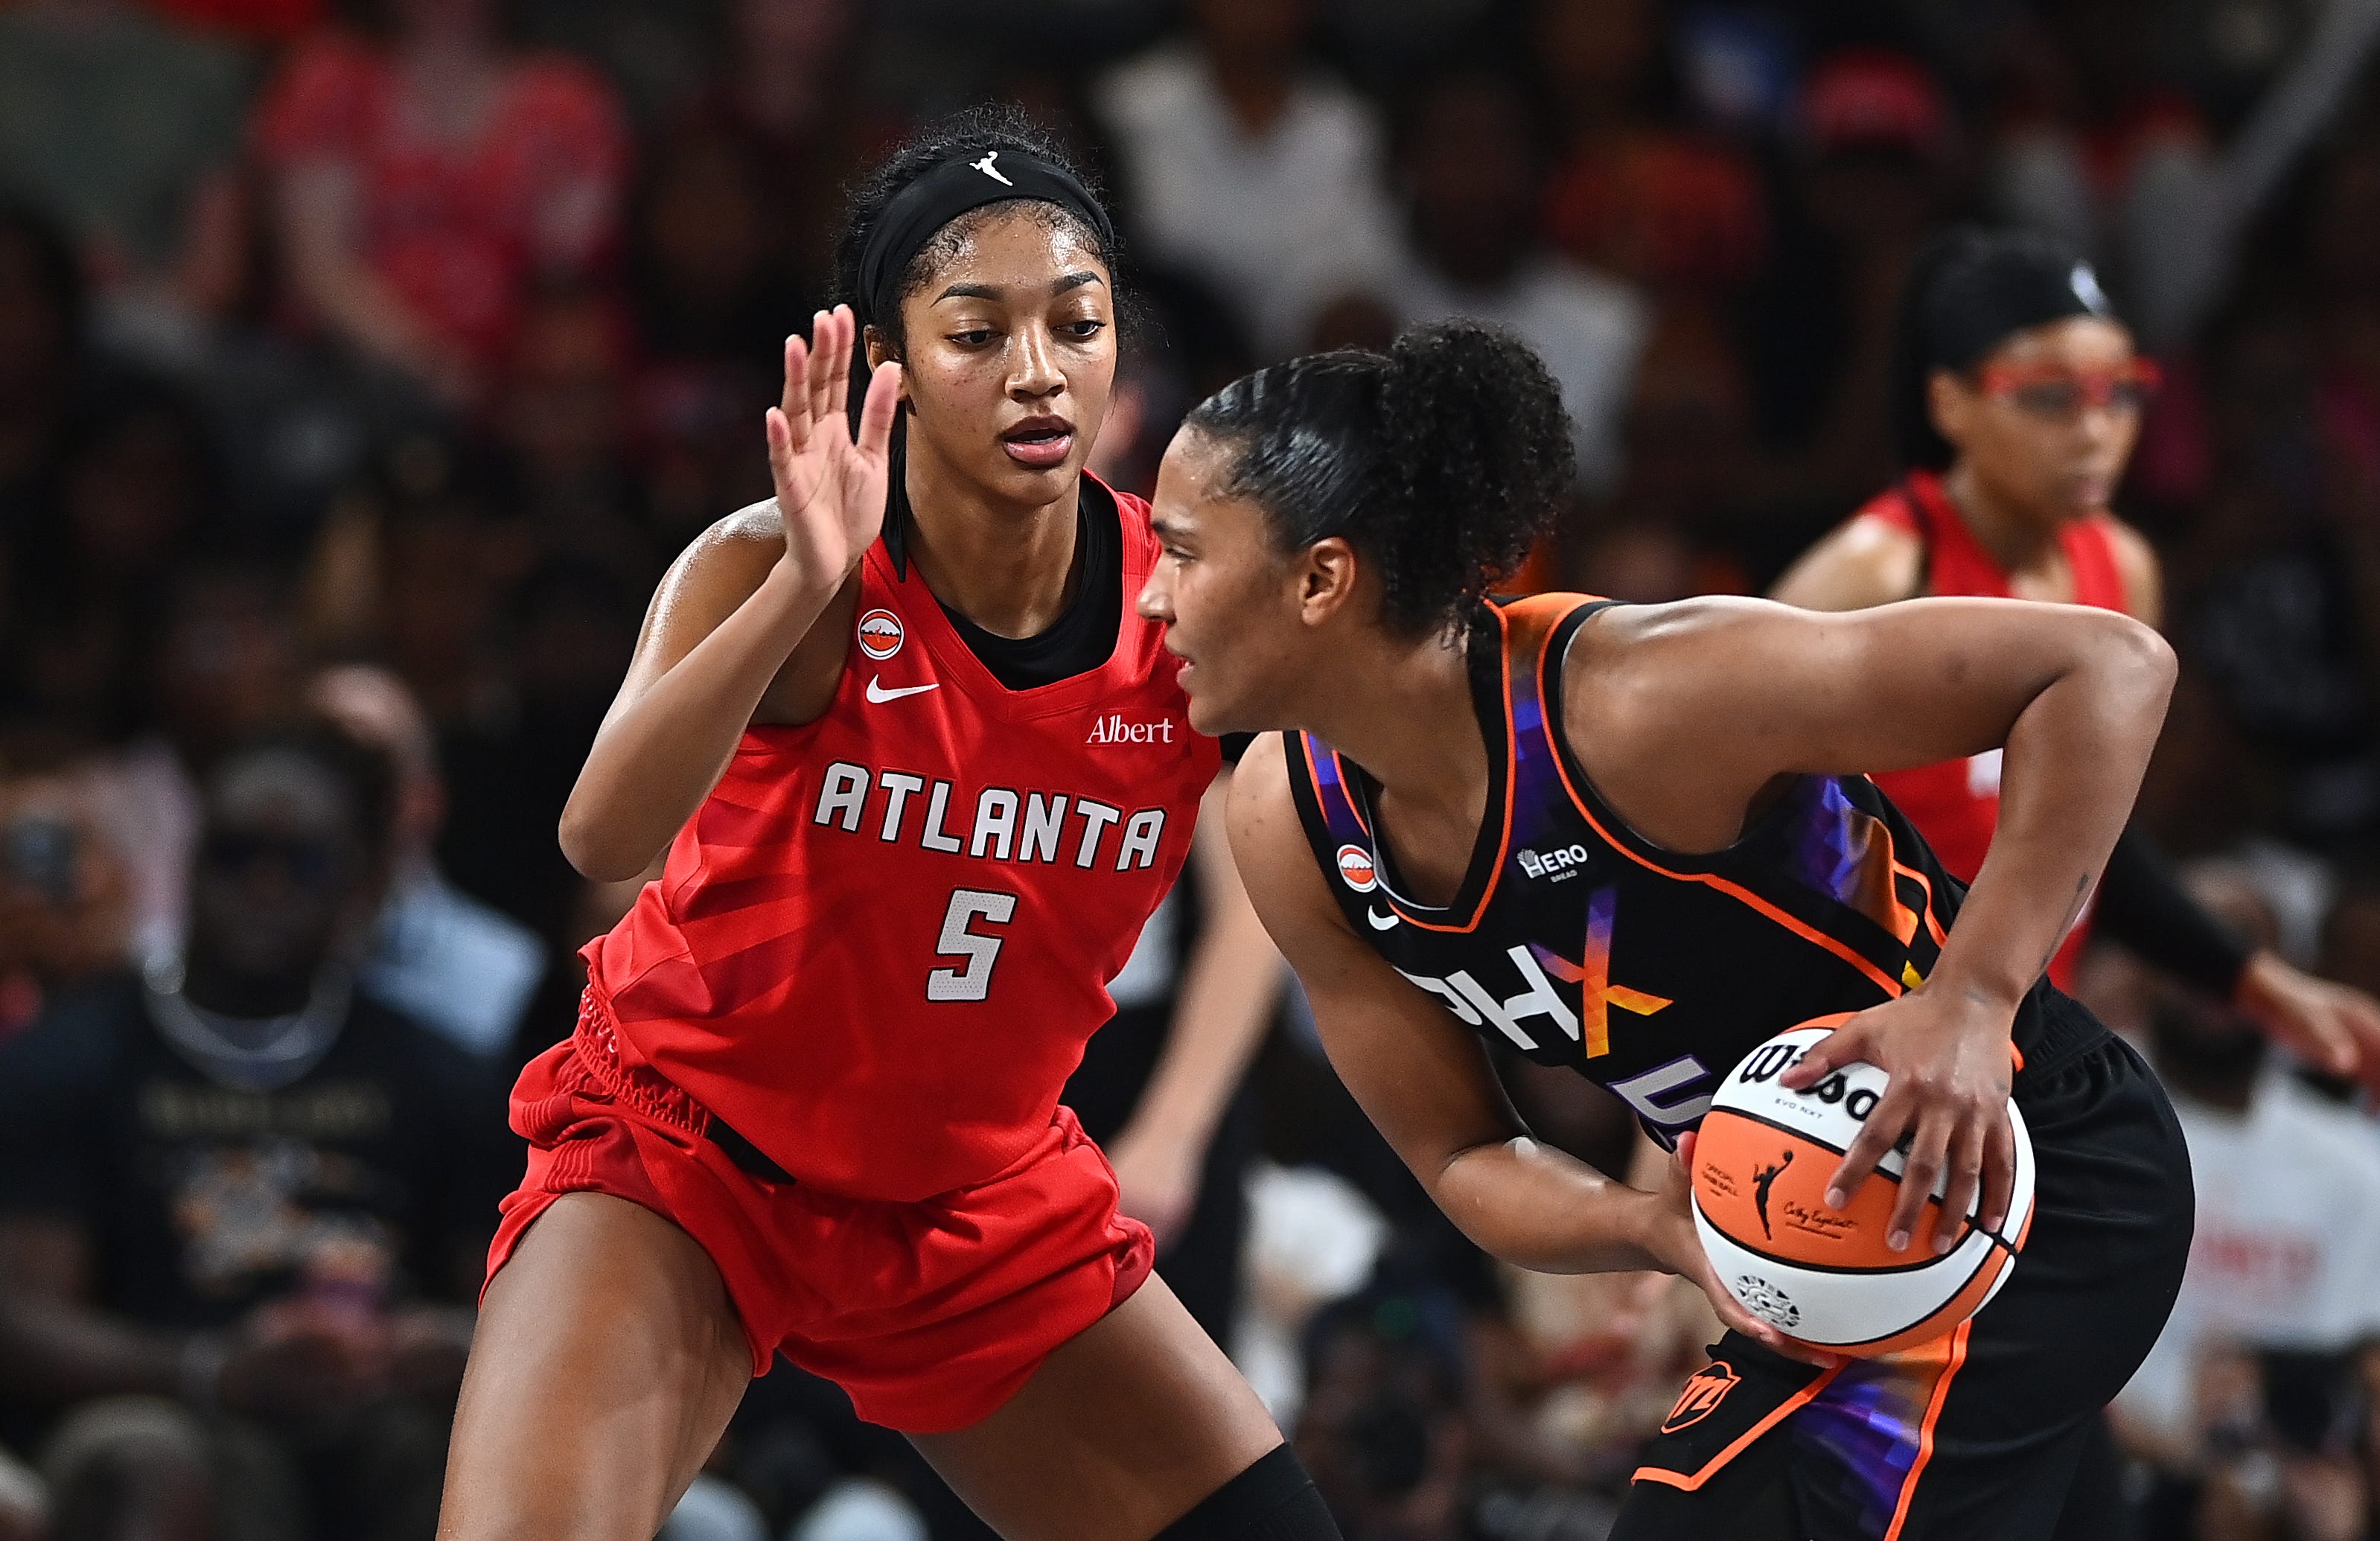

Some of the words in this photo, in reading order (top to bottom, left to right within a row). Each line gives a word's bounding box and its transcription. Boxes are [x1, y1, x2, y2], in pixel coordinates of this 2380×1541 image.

[1085, 715, 1174, 744] Albert
[814, 760, 1167, 872] ATLANTA
[1518, 844, 1588, 878] HERO
[925, 889, 1018, 1002] 5
